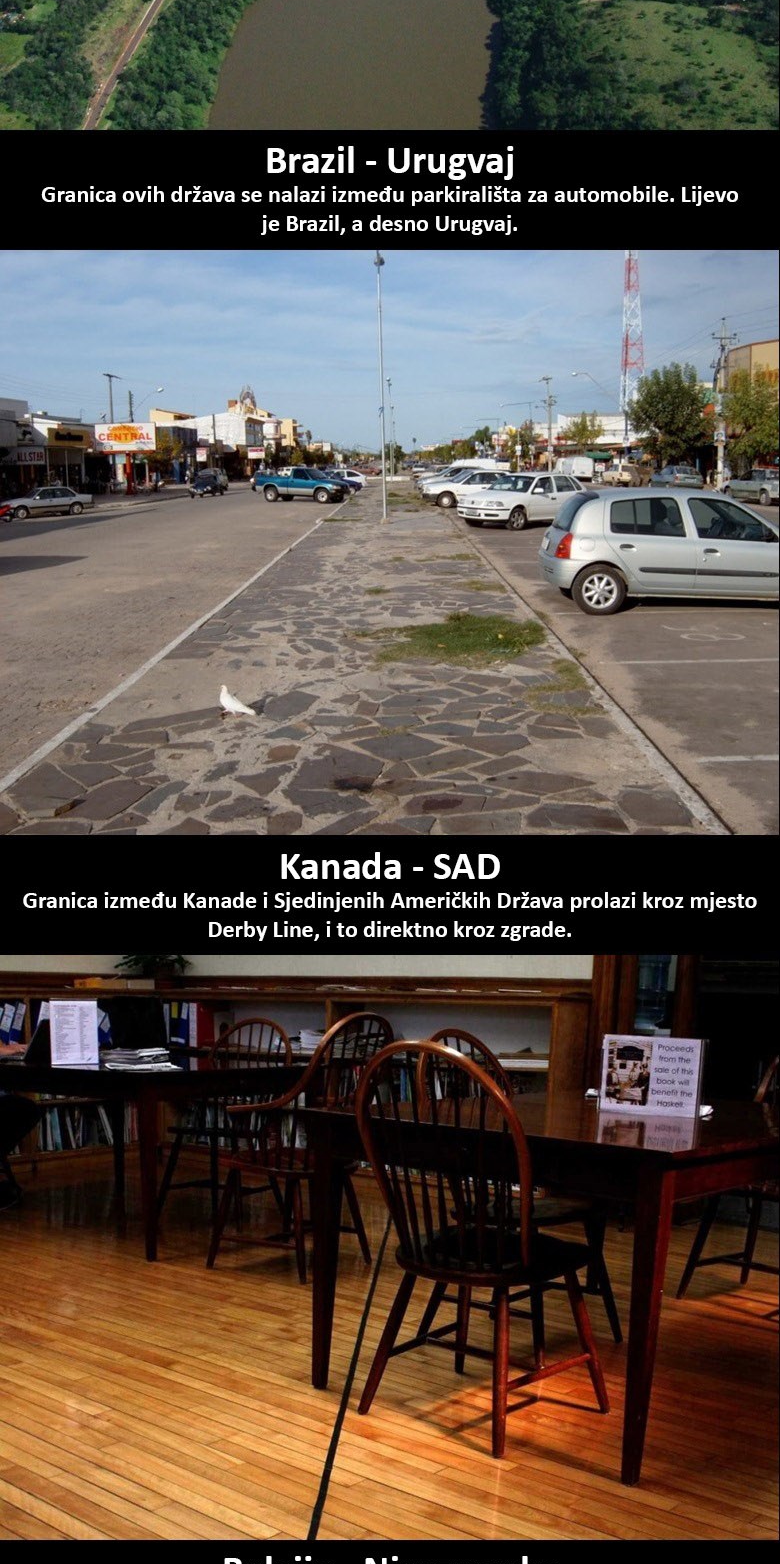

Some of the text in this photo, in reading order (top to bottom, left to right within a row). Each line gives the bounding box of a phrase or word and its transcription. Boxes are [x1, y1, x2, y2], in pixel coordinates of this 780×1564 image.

[98, 432, 153, 441] CENTRAL
[657, 1043, 695, 1053] Proceeds
[658, 1055, 691, 1064] from the
[671, 1067, 681, 1075] of
[656, 1078, 676, 1086] book
[651, 1088, 693, 1098] benefit the
